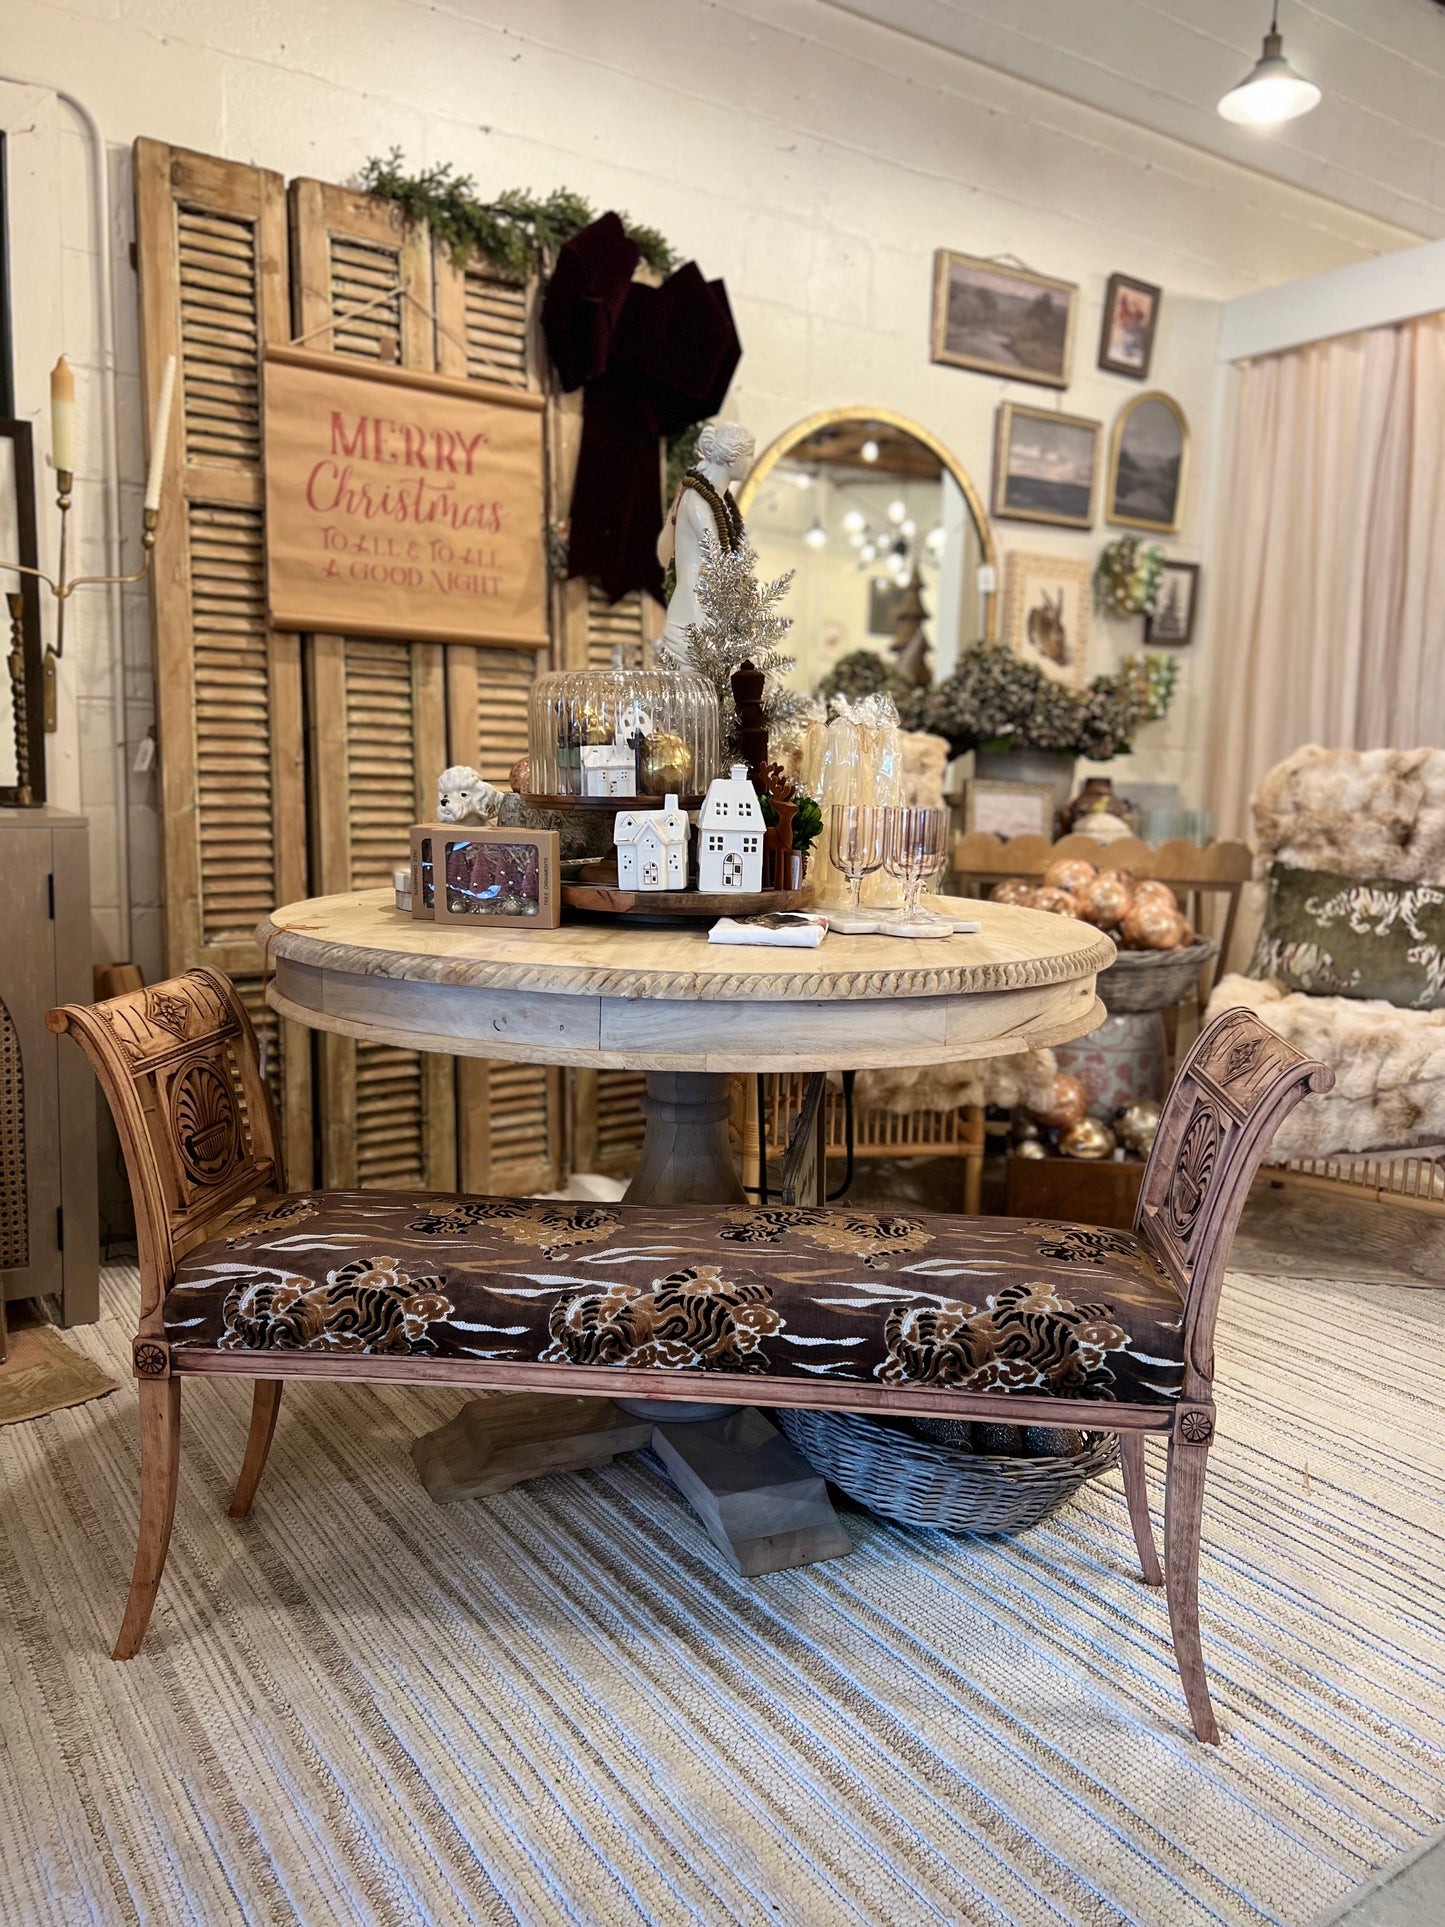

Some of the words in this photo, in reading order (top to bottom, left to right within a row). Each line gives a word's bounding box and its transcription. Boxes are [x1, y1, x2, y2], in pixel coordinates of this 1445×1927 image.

[330, 411, 489, 476] MERRY
[306, 459, 509, 533] Christmas
[321, 526, 348, 551] TO
[352, 534, 400, 557] ALL
[429, 538, 454, 563] TO
[460, 547, 502, 569] ALL
[323, 558, 340, 578] A
[350, 561, 423, 587] GOOD
[431, 569, 502, 596] NIGHT
